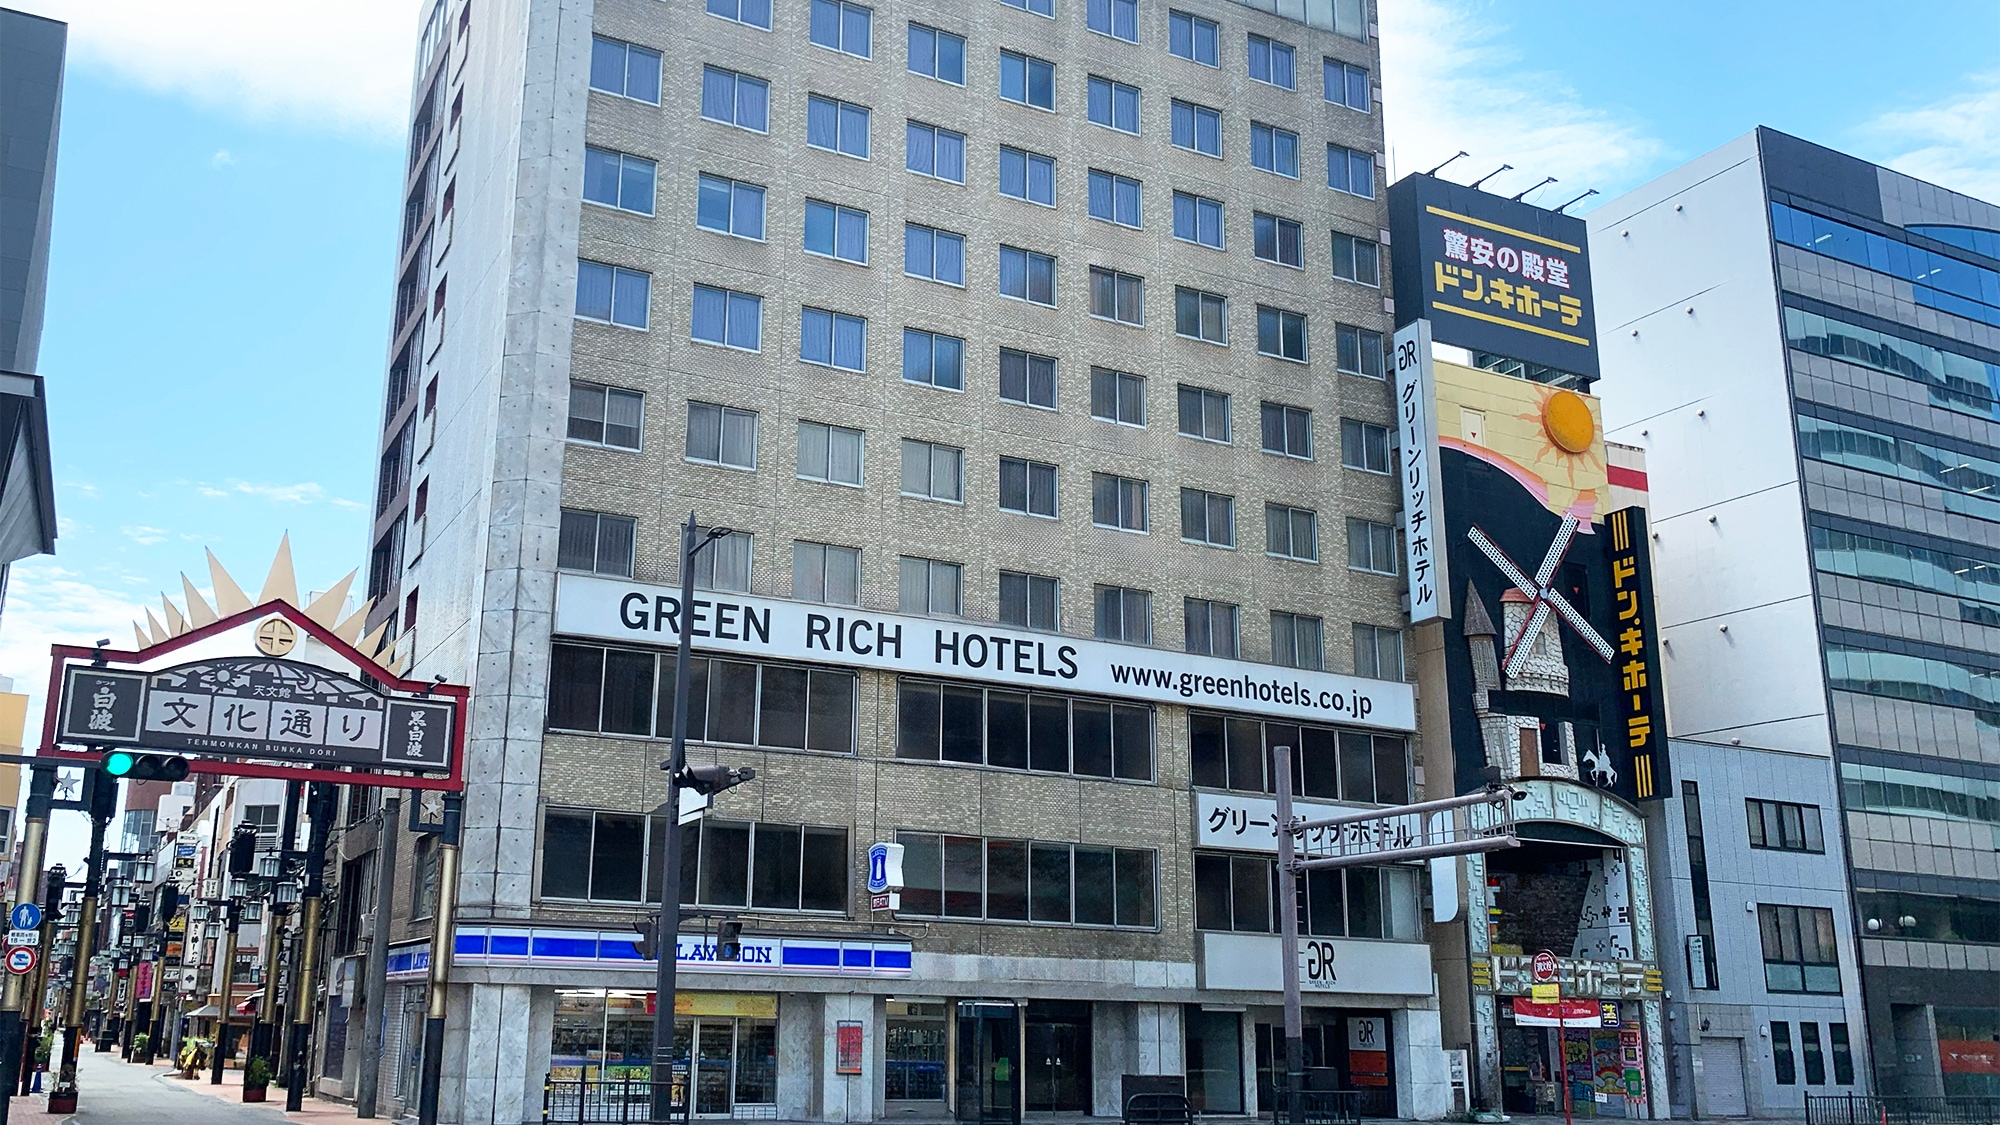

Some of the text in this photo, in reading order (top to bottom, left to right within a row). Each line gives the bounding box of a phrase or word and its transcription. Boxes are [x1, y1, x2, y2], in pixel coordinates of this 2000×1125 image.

[1443, 228, 1570, 289] 驚安の殿堂
[1402, 379, 1433, 606] グリーンリッチホテル
[620, 592, 1373, 719] GREEN RICH HOTELS www.greenhotels.co.jp
[88, 687, 117, 731] 白波
[253, 685, 291, 699] 天文館
[161, 697, 367, 742] 文化通り
[406, 711, 427, 757] 黒白波
[186, 738, 337, 757] TENMONKAN BUNKA DORI
